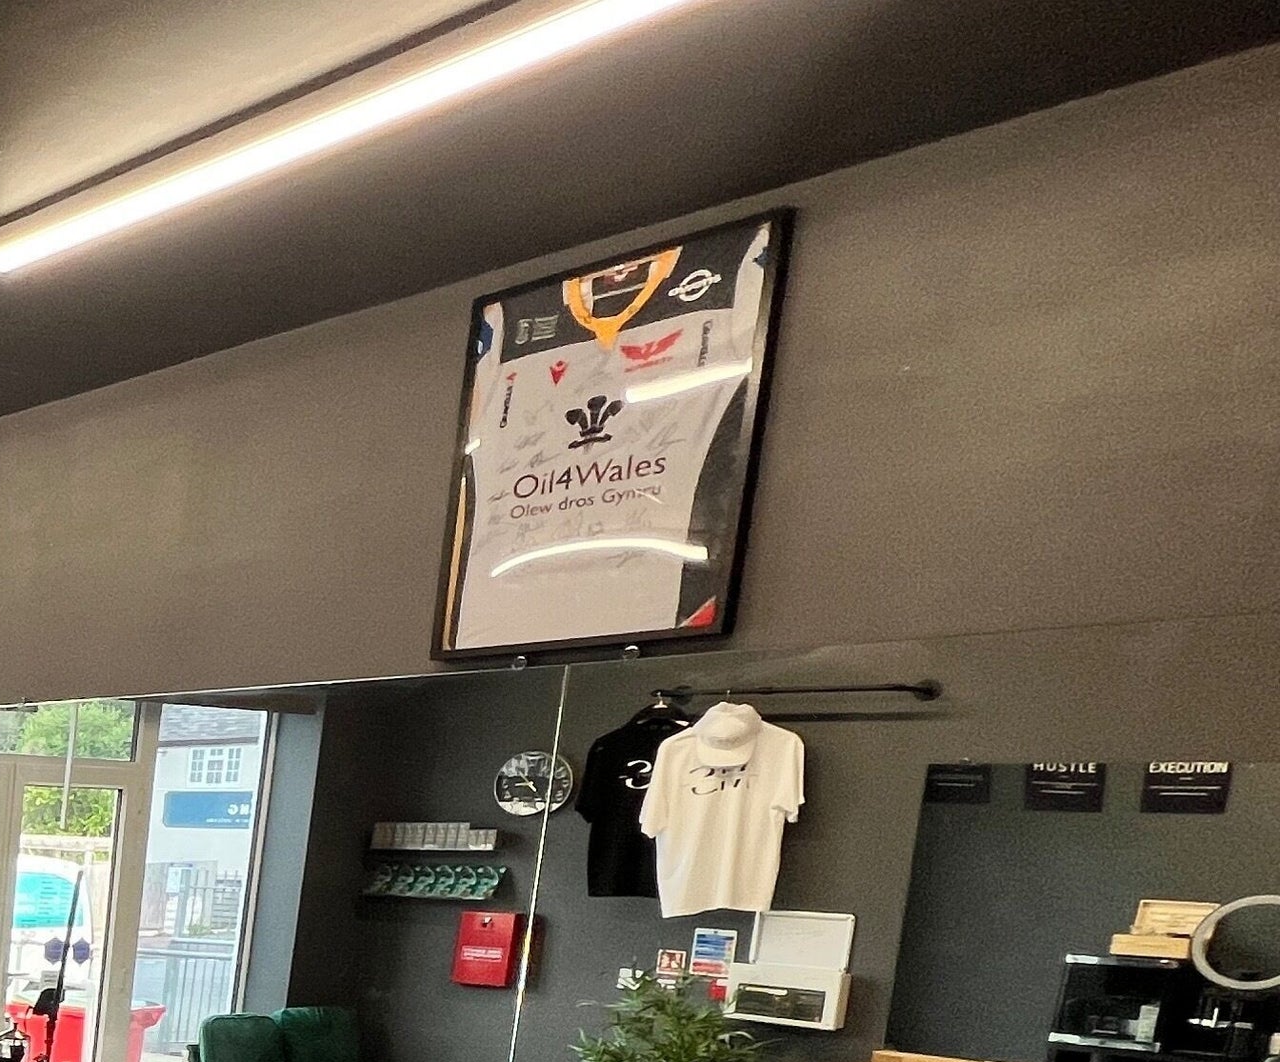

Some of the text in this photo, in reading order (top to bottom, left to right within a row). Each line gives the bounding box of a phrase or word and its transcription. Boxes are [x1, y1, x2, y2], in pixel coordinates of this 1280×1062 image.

[513, 454, 667, 498] Oil4Wales
[510, 502, 553, 519] Olew
[558, 496, 594, 511] dros
[1148, 761, 1229, 774] EXECUTION
